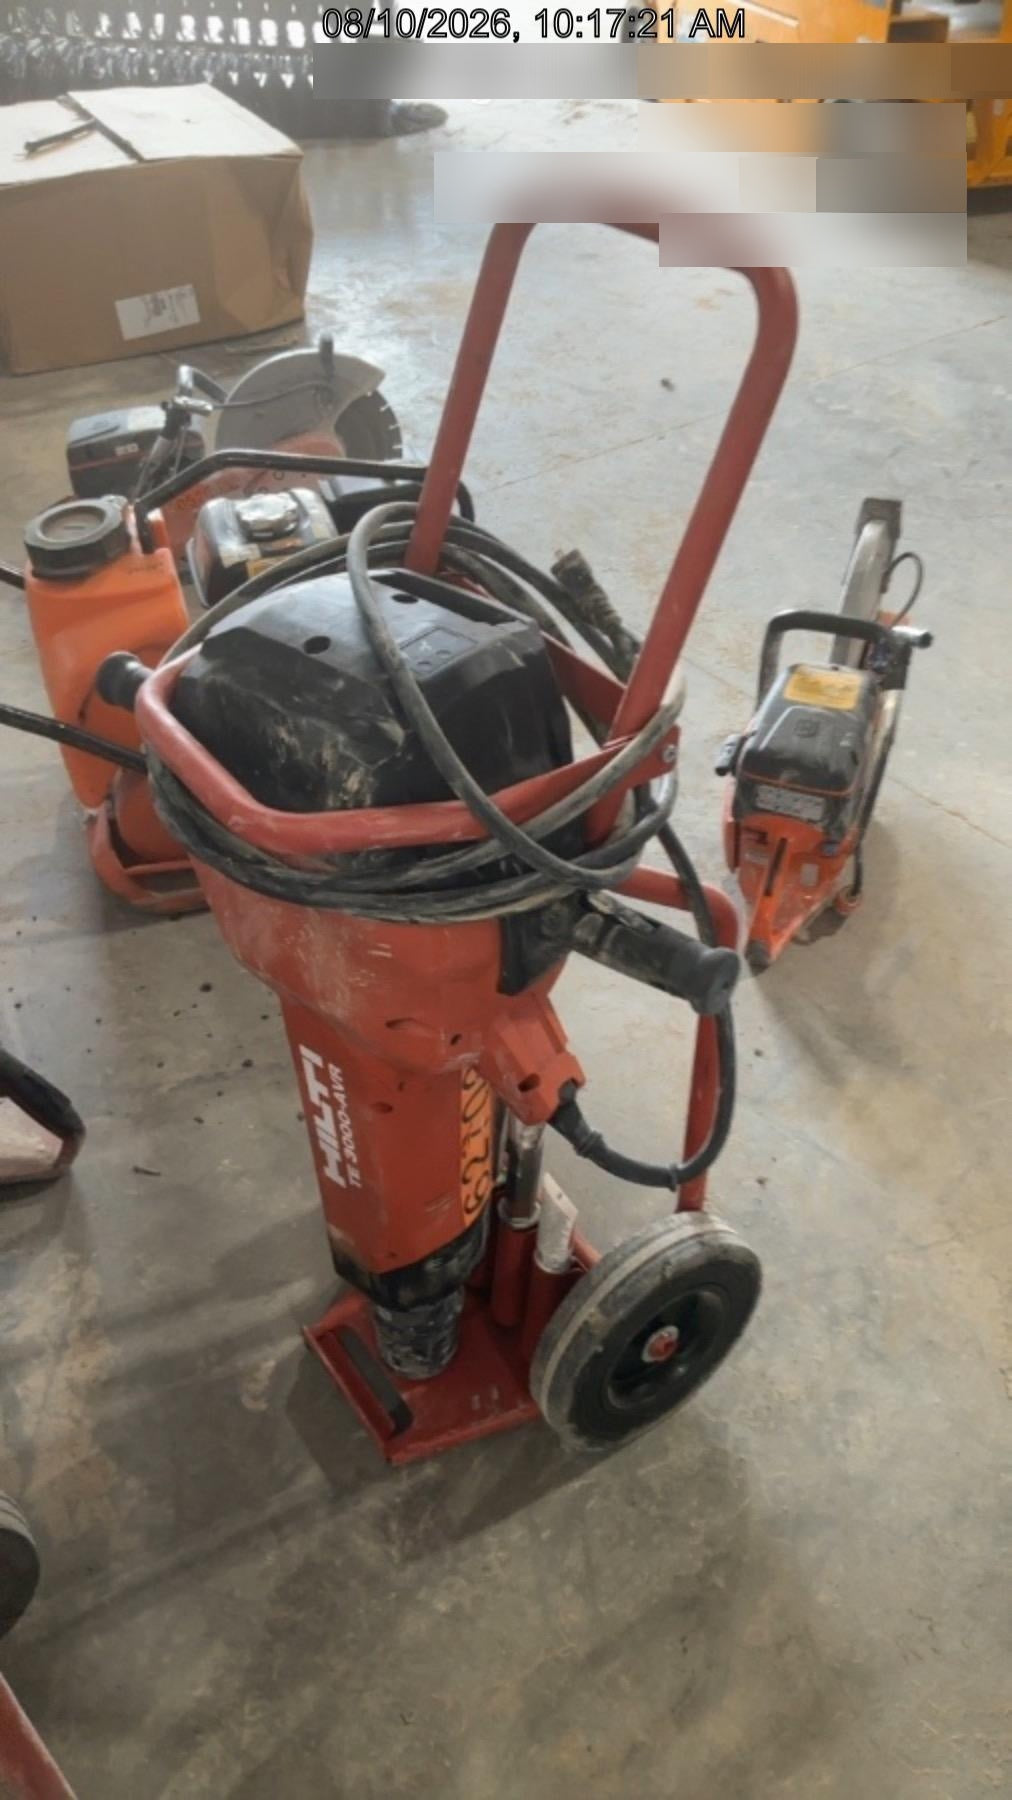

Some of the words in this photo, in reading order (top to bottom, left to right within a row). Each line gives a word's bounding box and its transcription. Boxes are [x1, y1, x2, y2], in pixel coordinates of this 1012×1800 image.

[299, 1044, 347, 1188] HILTI
[328, 1063, 357, 1163] 3000-AVR
[347, 1164, 362, 1188] TE
